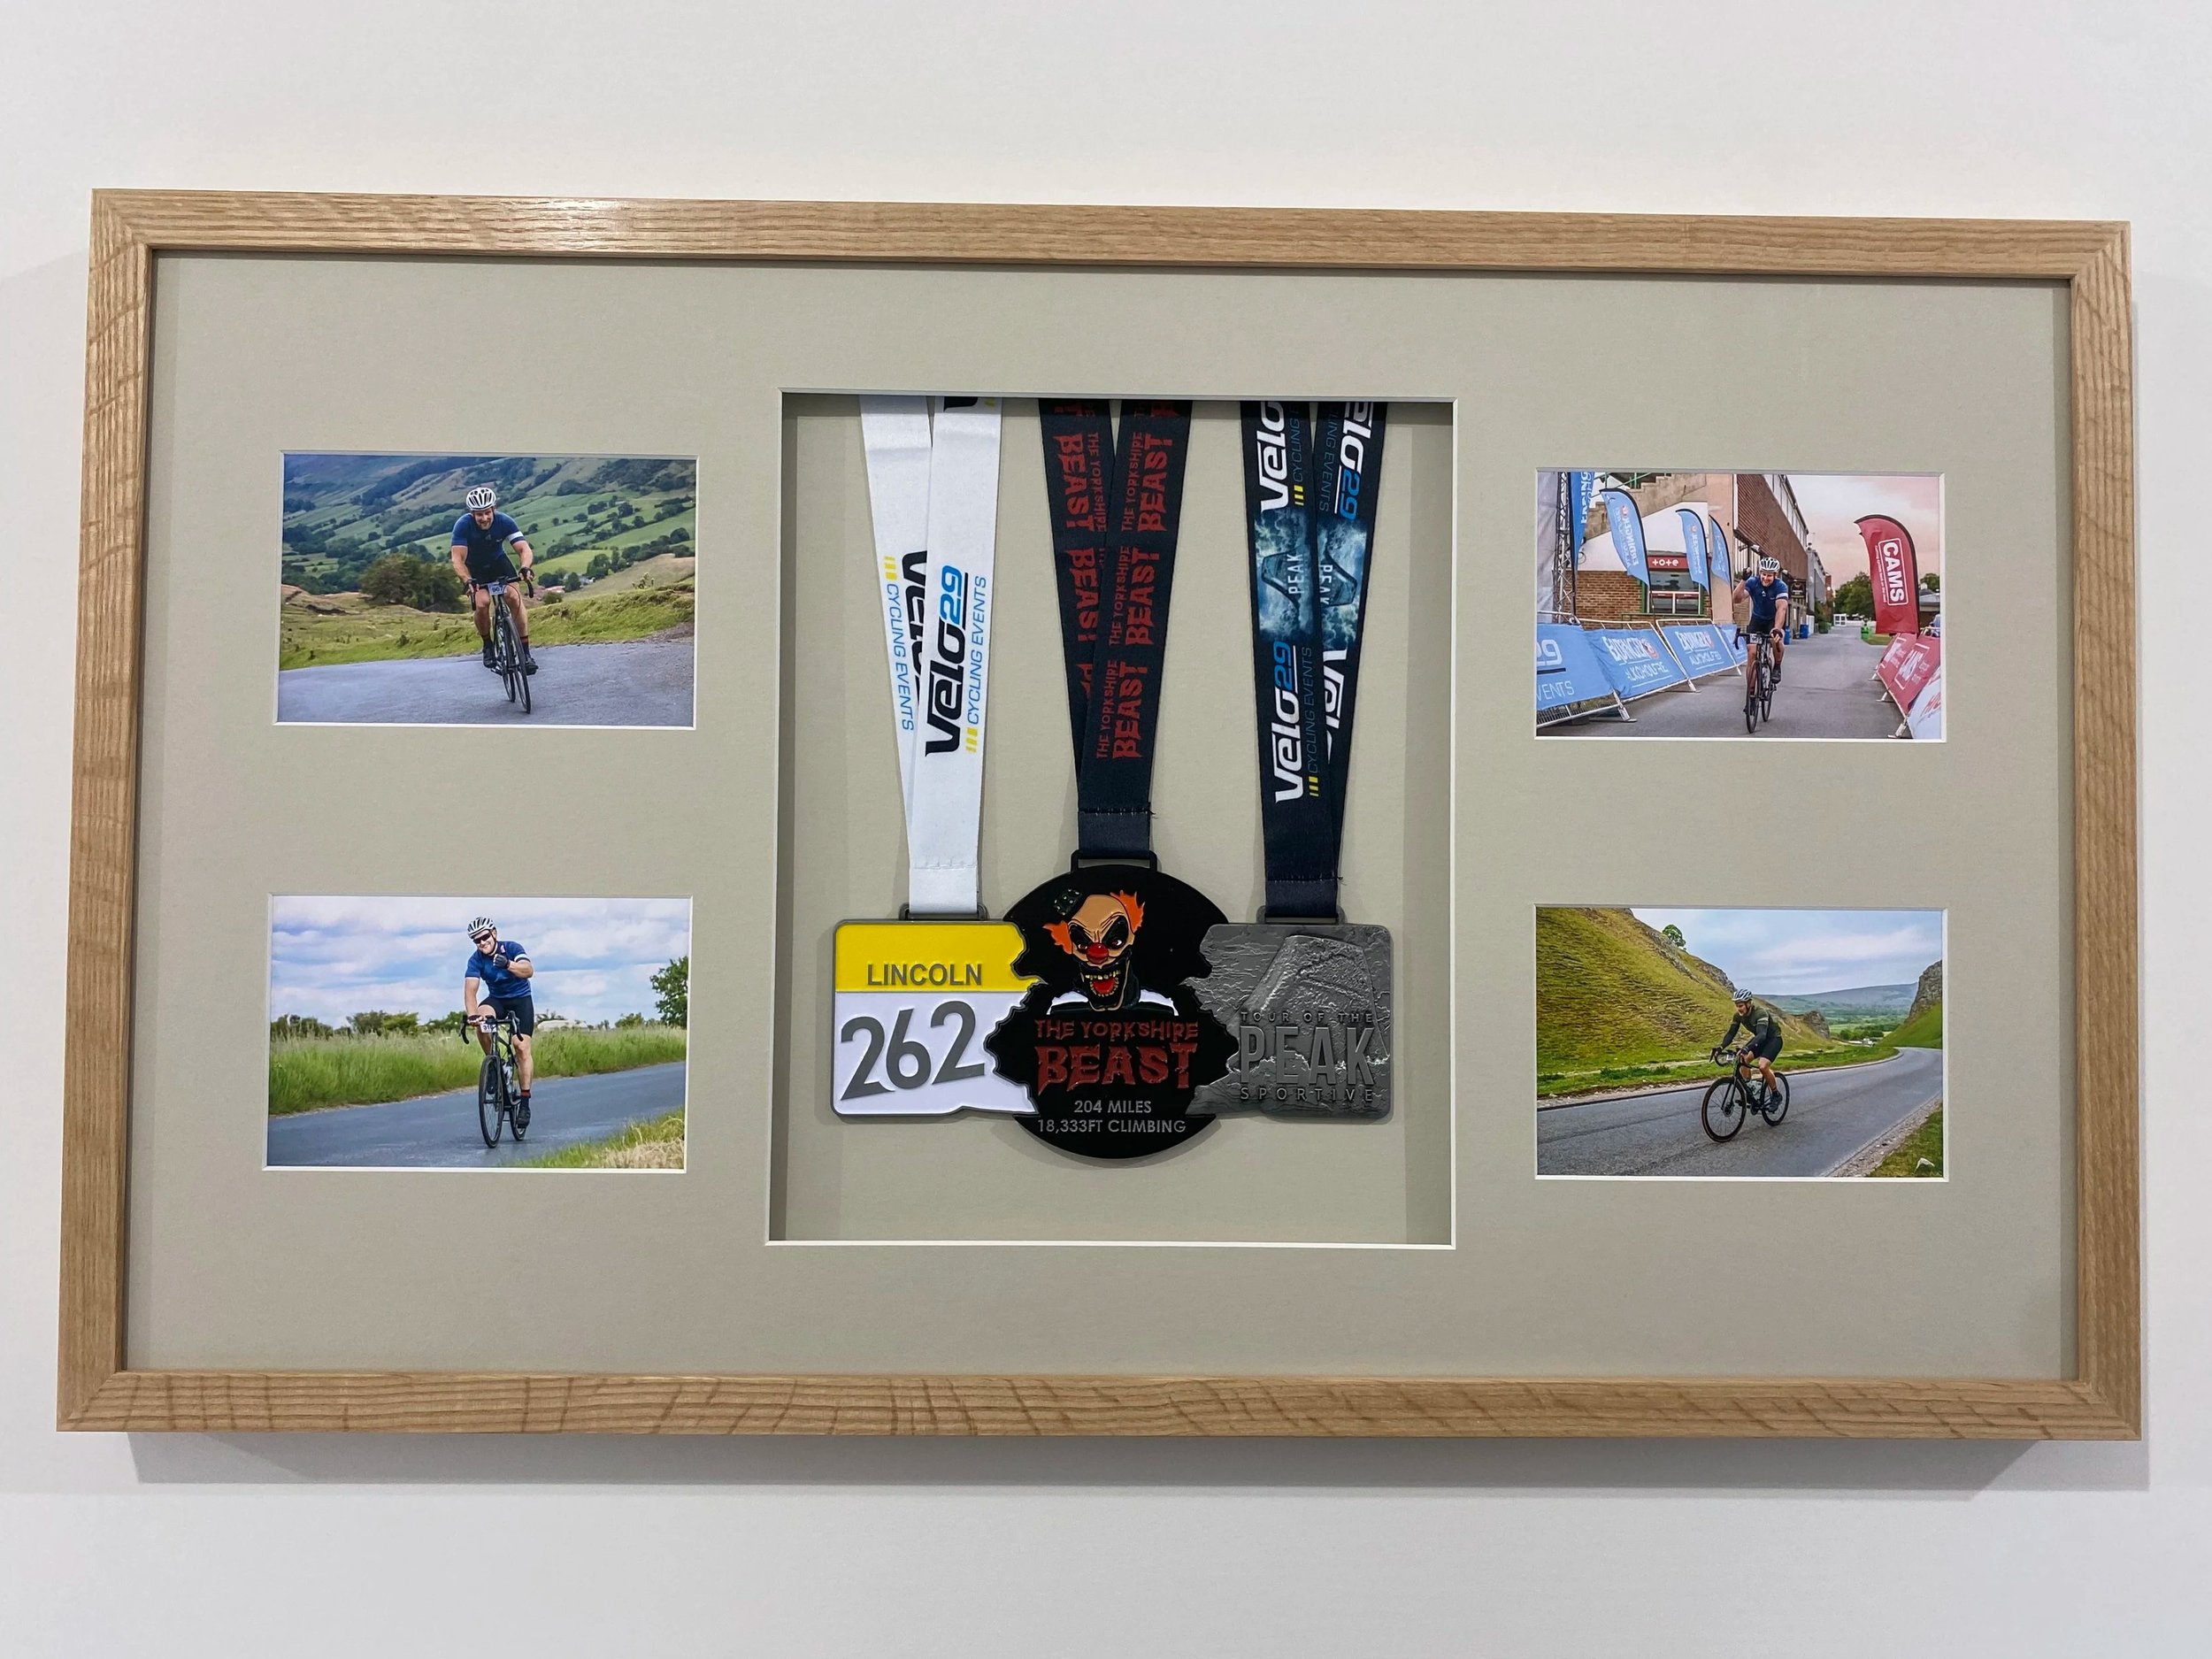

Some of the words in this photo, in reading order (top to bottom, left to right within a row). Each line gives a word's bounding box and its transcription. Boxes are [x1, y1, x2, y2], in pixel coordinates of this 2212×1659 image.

[1087, 431, 1100, 457] THE
[1125, 432, 1143, 503] YORKSHIRE
[1089, 460, 1108, 532] YORKSHIRE
[1318, 451, 1335, 512] EVENTS
[1121, 508, 1135, 532] THE
[1115, 546, 1133, 617] YORKSHIRE
[1286, 554, 1305, 595] PEAK
[1652, 558, 1679, 567] tote
[1883, 541, 1905, 603] CAMS
[887, 583, 907, 657] CYCLING
[972, 575, 987, 646] EVENTS
[1109, 621, 1123, 646] THE
[895, 662, 915, 731] EVENTS
[967, 649, 983, 725] CYCLING
[1101, 659, 1119, 730] YORKSHIRE
[1301, 647, 1313, 706] EVENTS
[1095, 734, 1110, 759] THE
[1303, 711, 1319, 774] CYCLING
[867, 964, 982, 987] LINCOLN
[1034, 1019, 1075, 1041] THE
[1080, 1020, 1199, 1042] YORKSHIRE
[1240, 1010, 1291, 1023] TOUR
[1303, 1011, 1325, 1023] OF
[1338, 1012, 1373, 1024] THE
[841, 1000, 986, 1102] 262
[1034, 1042, 1198, 1096] BEAST
[1240, 1025, 1376, 1086] PEAK
[1073, 1099, 1102, 1114] 204
[1107, 1100, 1152, 1114] MILES
[1240, 1087, 1374, 1102] SPORTIVE
[1037, 1118, 1103, 1134] 18,333FT
[1108, 1119, 1187, 1133] CLIMBING
